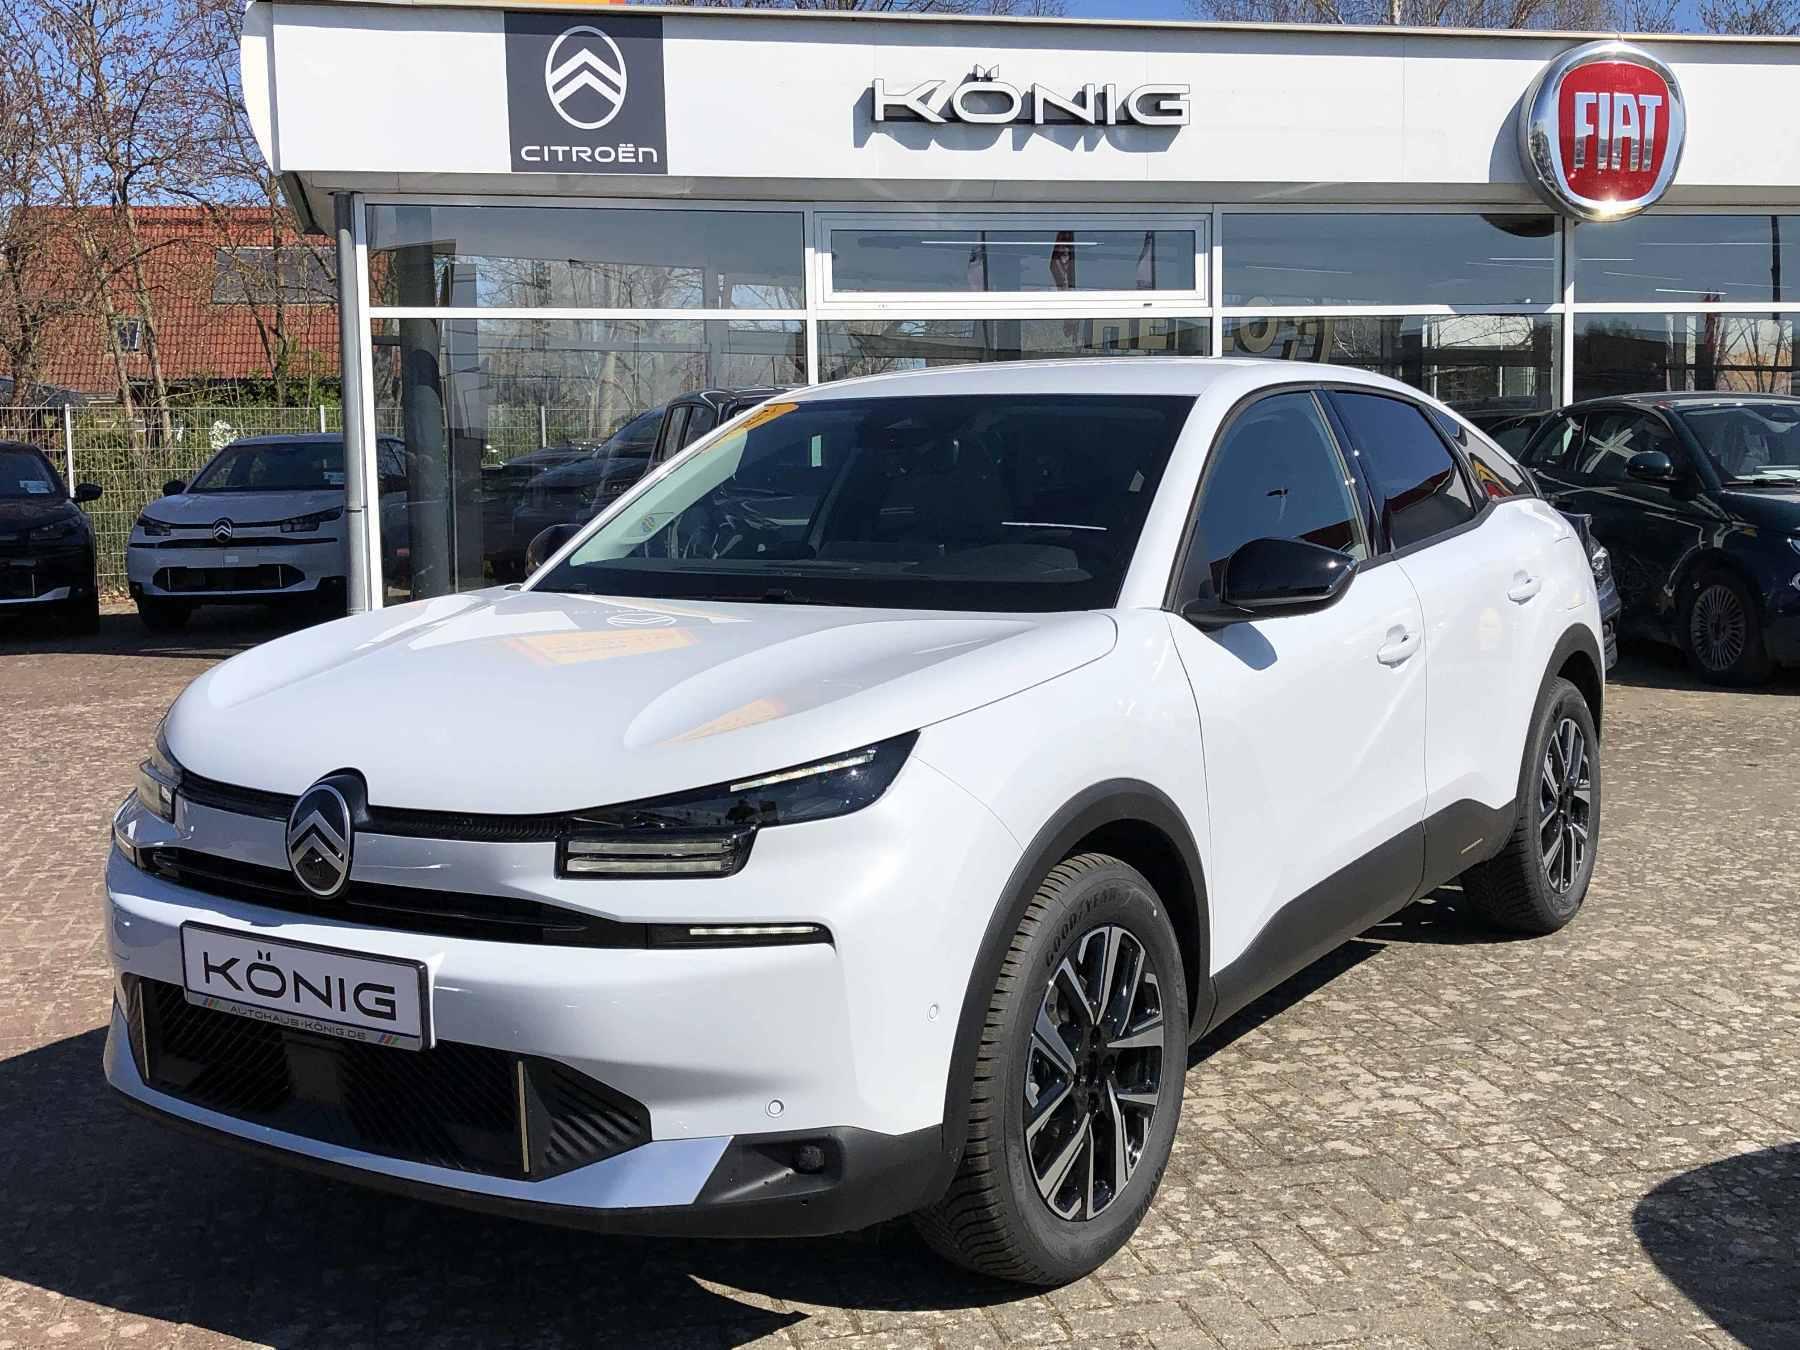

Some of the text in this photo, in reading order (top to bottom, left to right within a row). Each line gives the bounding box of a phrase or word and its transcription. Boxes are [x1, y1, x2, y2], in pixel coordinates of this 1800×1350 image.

[873, 64, 1192, 127] KÖNIG
[1573, 91, 1663, 172] FIAT
[202, 949, 397, 1021] KÖNIG
